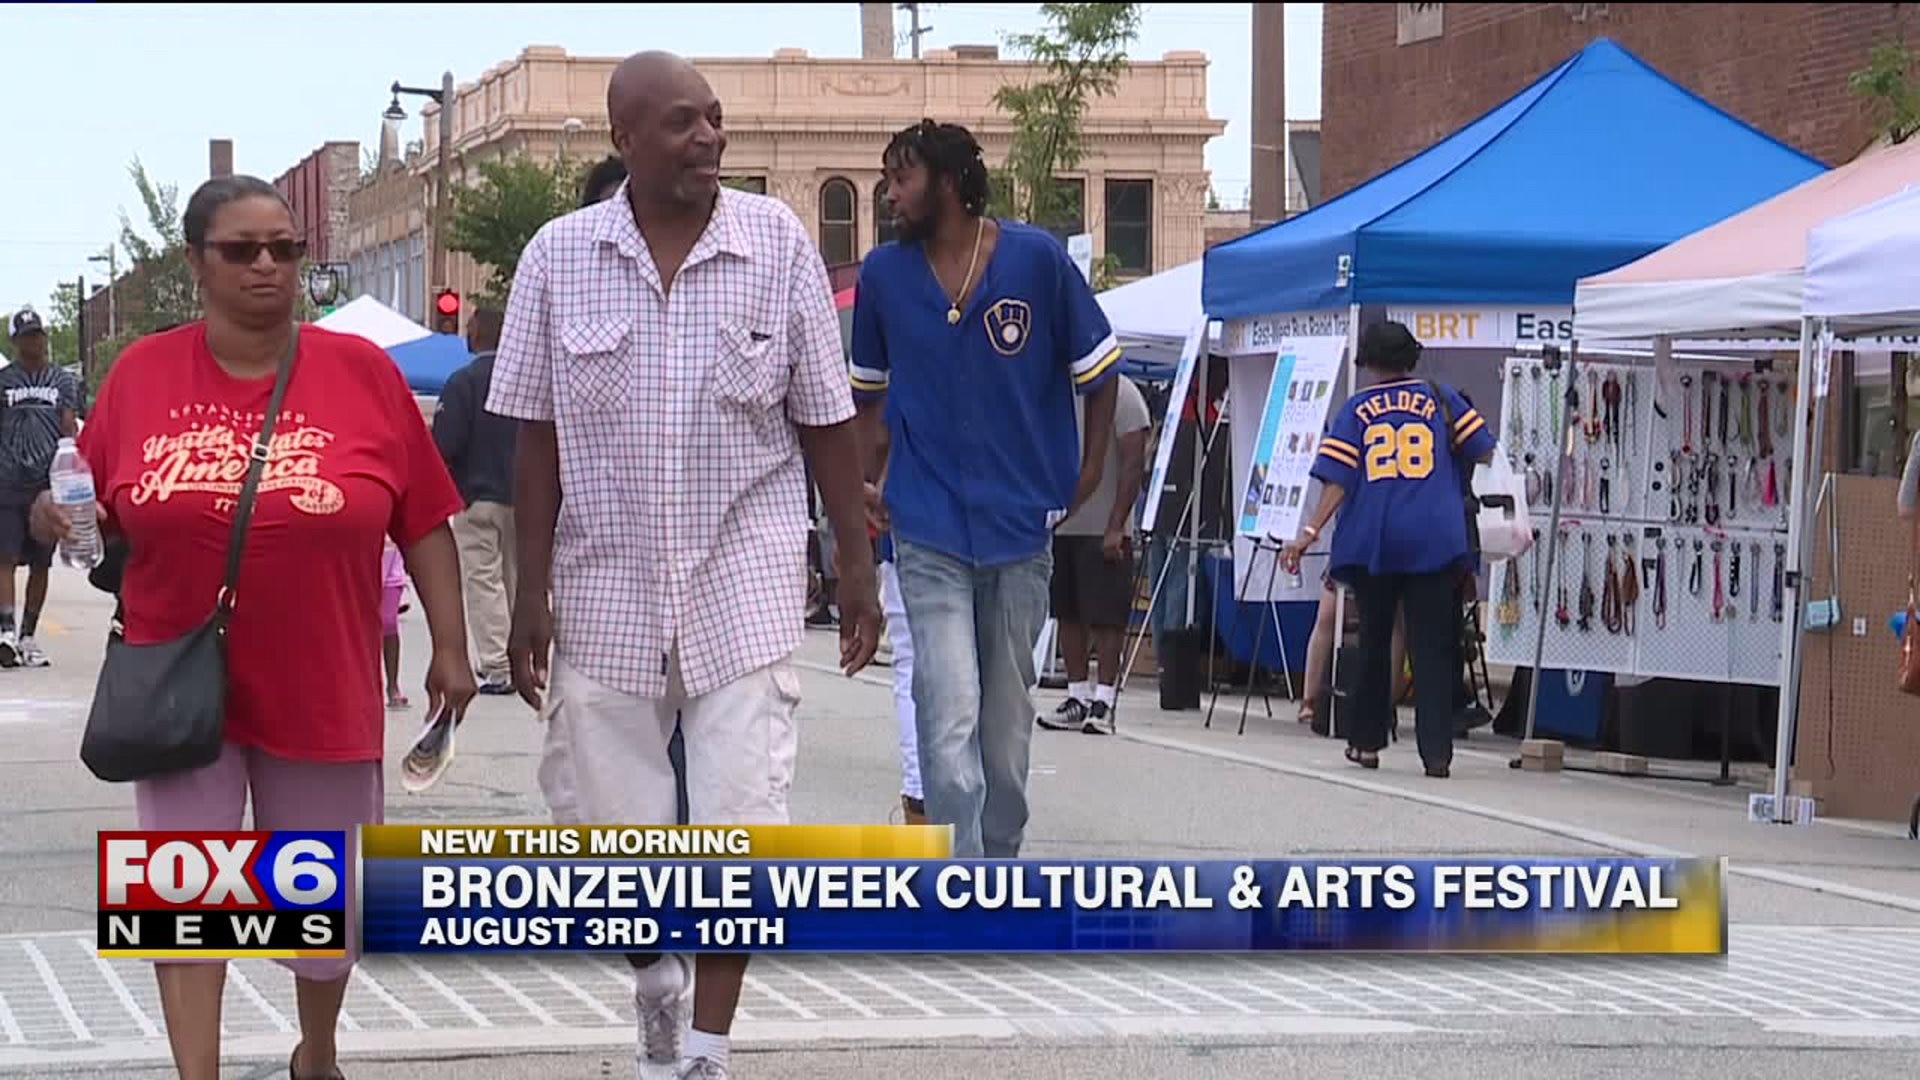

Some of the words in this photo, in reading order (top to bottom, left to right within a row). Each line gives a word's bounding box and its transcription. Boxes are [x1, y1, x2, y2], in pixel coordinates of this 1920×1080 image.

[1415, 312, 1480, 339] BRT
[169, 402, 306, 425] ESTABLISED
[1356, 390, 1437, 426] FIELDER
[1363, 422, 1434, 482] 28
[131, 449, 318, 505] Ameica
